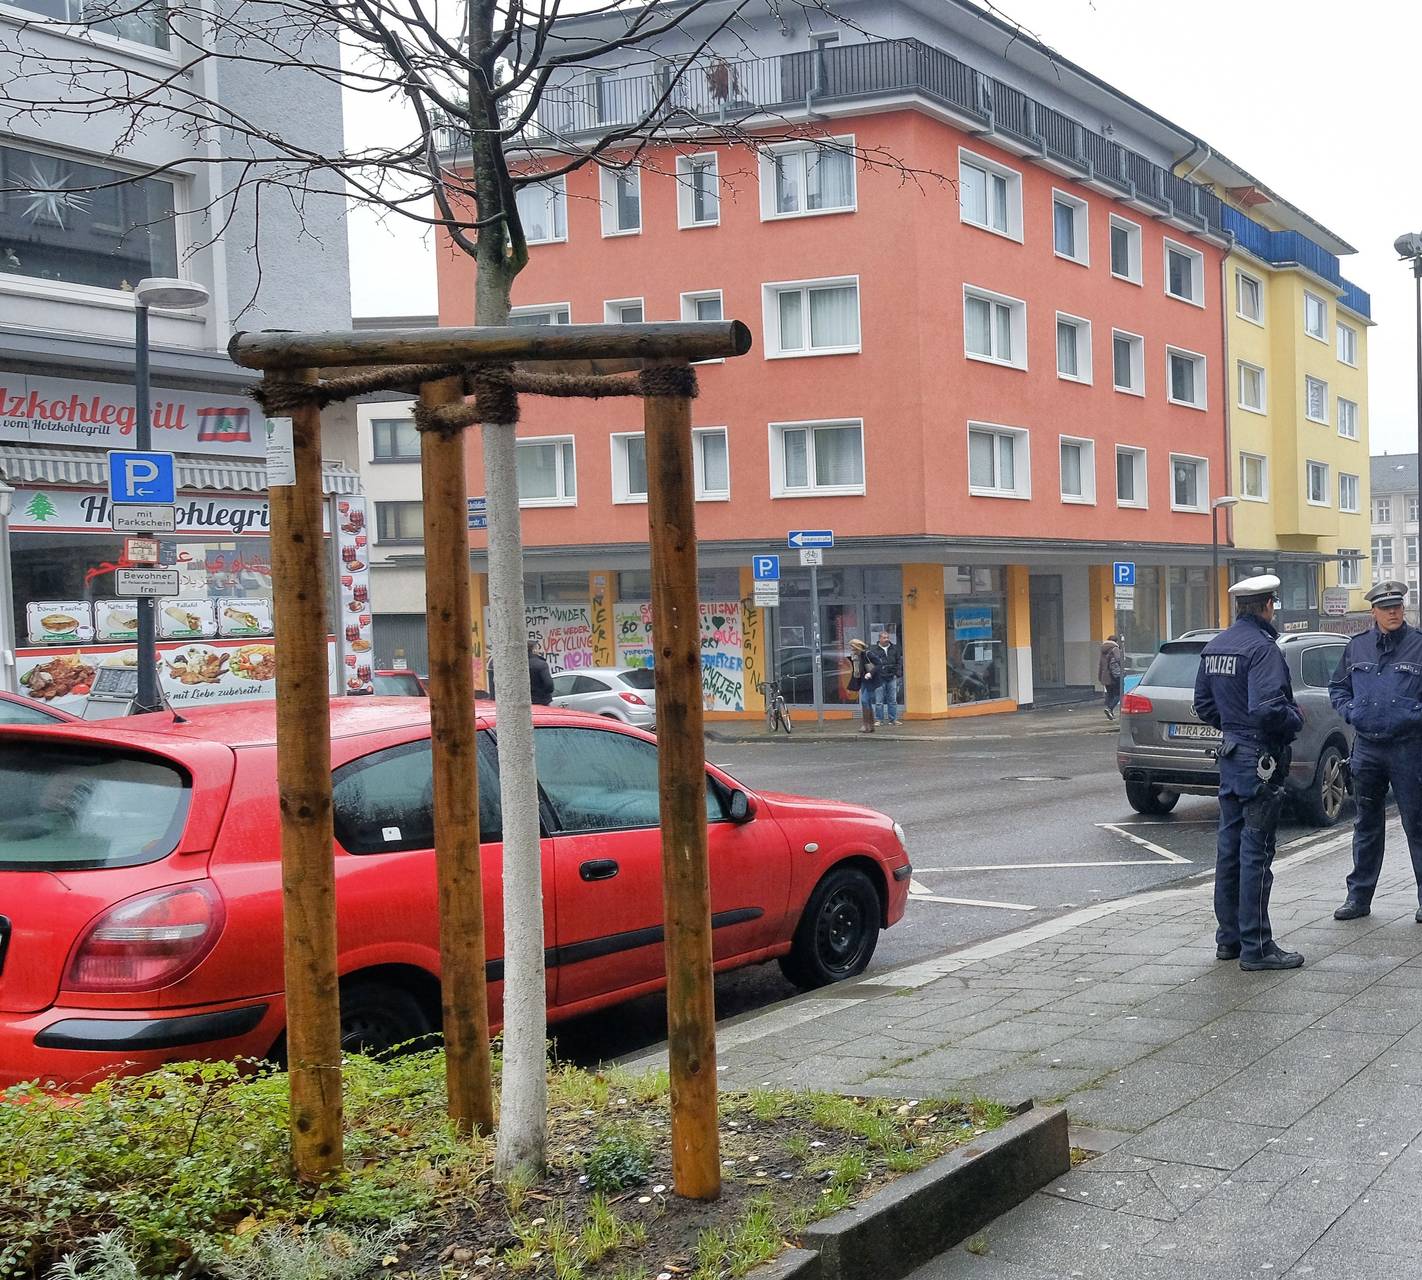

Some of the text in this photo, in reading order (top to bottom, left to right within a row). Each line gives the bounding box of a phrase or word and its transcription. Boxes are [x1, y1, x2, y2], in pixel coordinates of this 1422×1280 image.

[0, 387, 189, 435] lzkohlegill
[3, 419, 111, 436] vom Holzkohlegrill
[125, 459, 159, 497] P
[117, 518, 172, 528] Parkschein
[123, 571, 172, 580] Bewohner
[759, 559, 773, 577] P
[1118, 565, 1130, 582] P
[1205, 655, 1237, 675] POLIZEI
[173, 690, 189, 700] mit
[190, 688, 214, 699] Liebe
